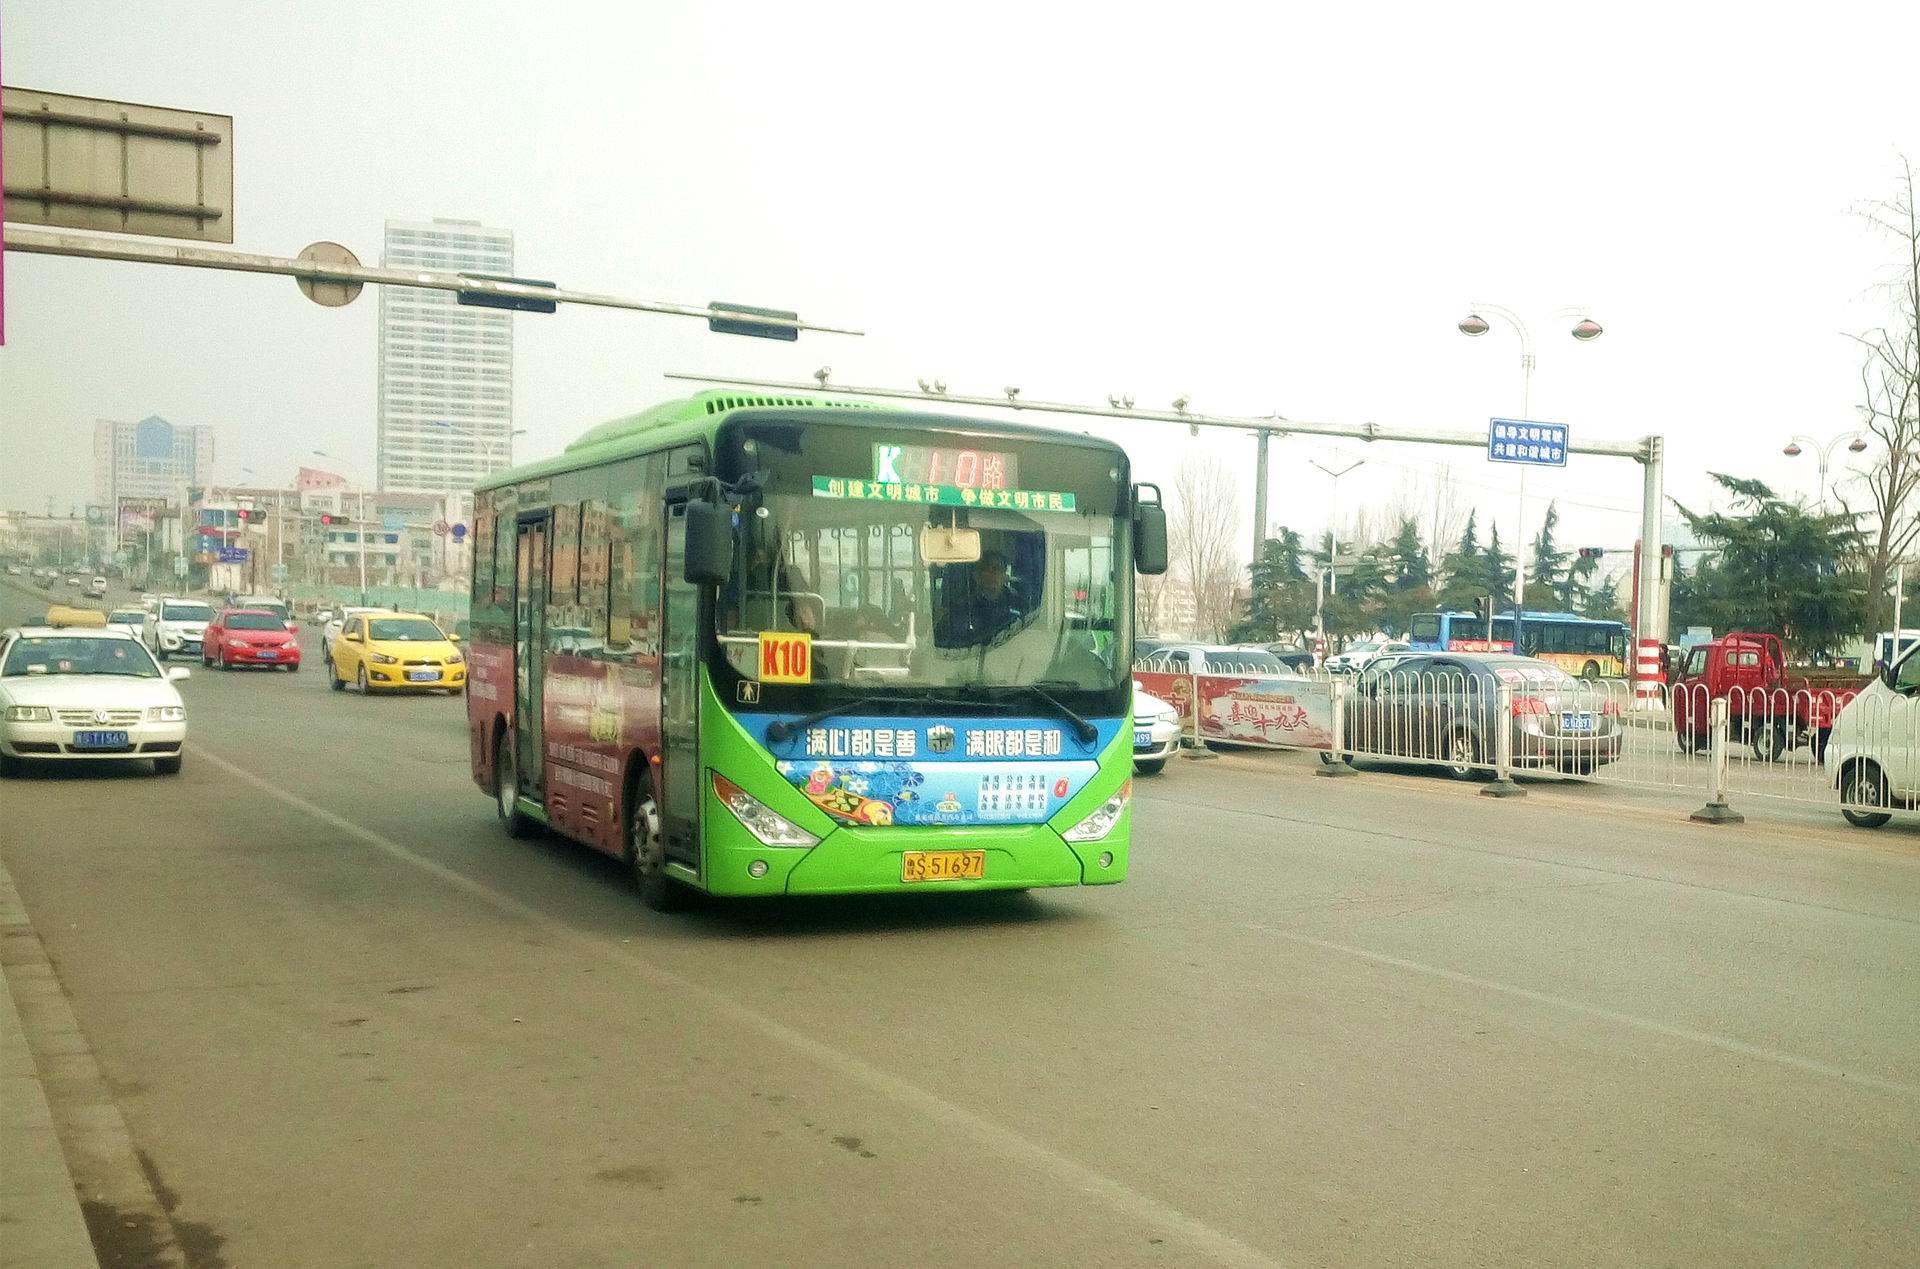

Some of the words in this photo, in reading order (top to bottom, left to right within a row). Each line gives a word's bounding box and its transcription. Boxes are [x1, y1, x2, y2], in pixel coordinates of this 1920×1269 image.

[1493, 442, 1562, 460] 共建和谐城市
[828, 479, 940, 502] 创建文明城市
[960, 488, 1063, 511] 争做文明市民
[763, 639, 806, 677] K10
[805, 728, 916, 757] 满心都是善
[965, 729, 1062, 757] 满眼都是和
